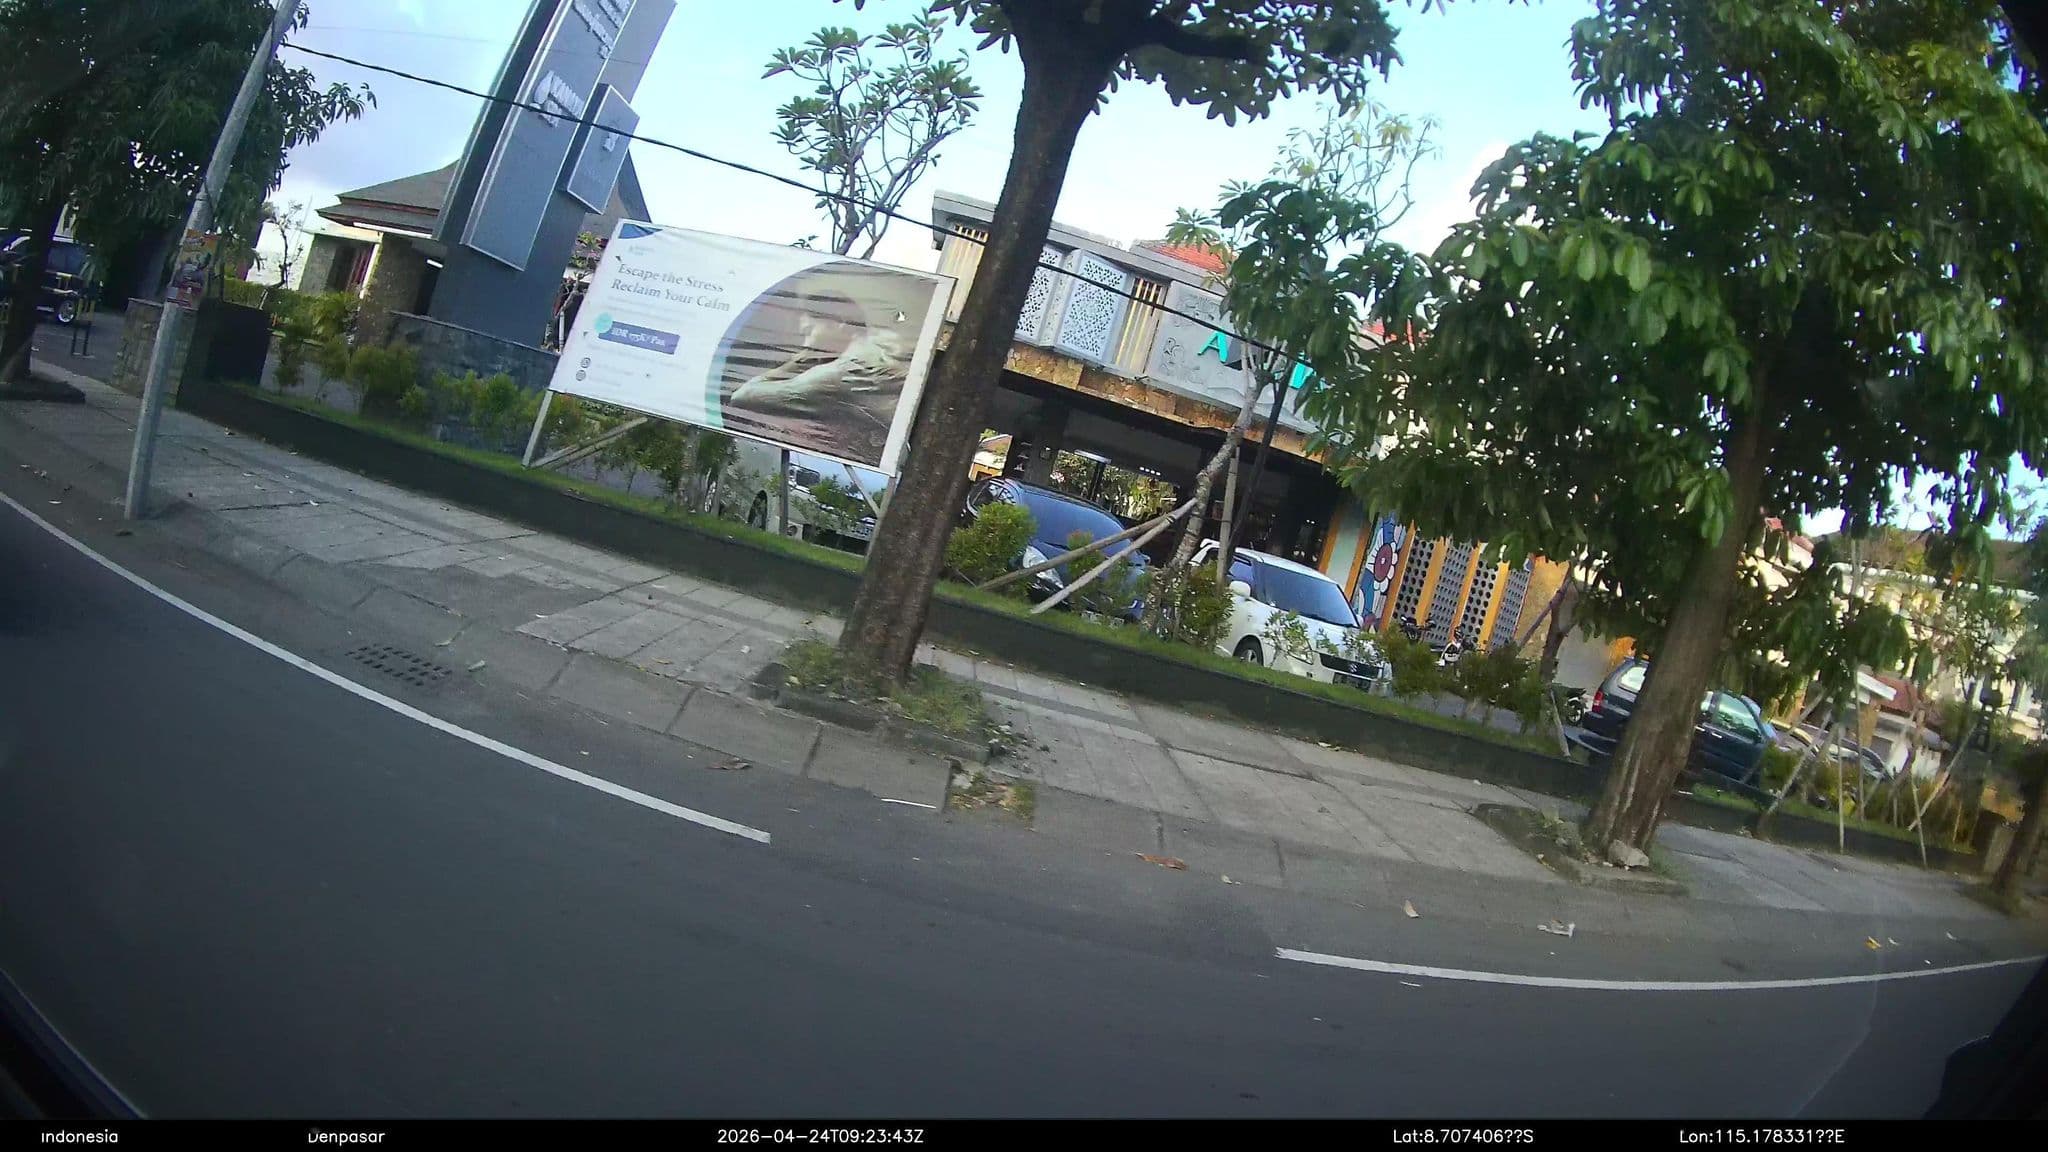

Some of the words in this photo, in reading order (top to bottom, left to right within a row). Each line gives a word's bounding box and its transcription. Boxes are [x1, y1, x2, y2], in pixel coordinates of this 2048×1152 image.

[618, 263, 660, 281] Escape
[662, 271, 683, 285] the
[686, 275, 724, 293] Stress
[611, 278, 661, 298] Reclaim
[664, 288, 694, 304] Your
[696, 295, 731, 312] Calm
